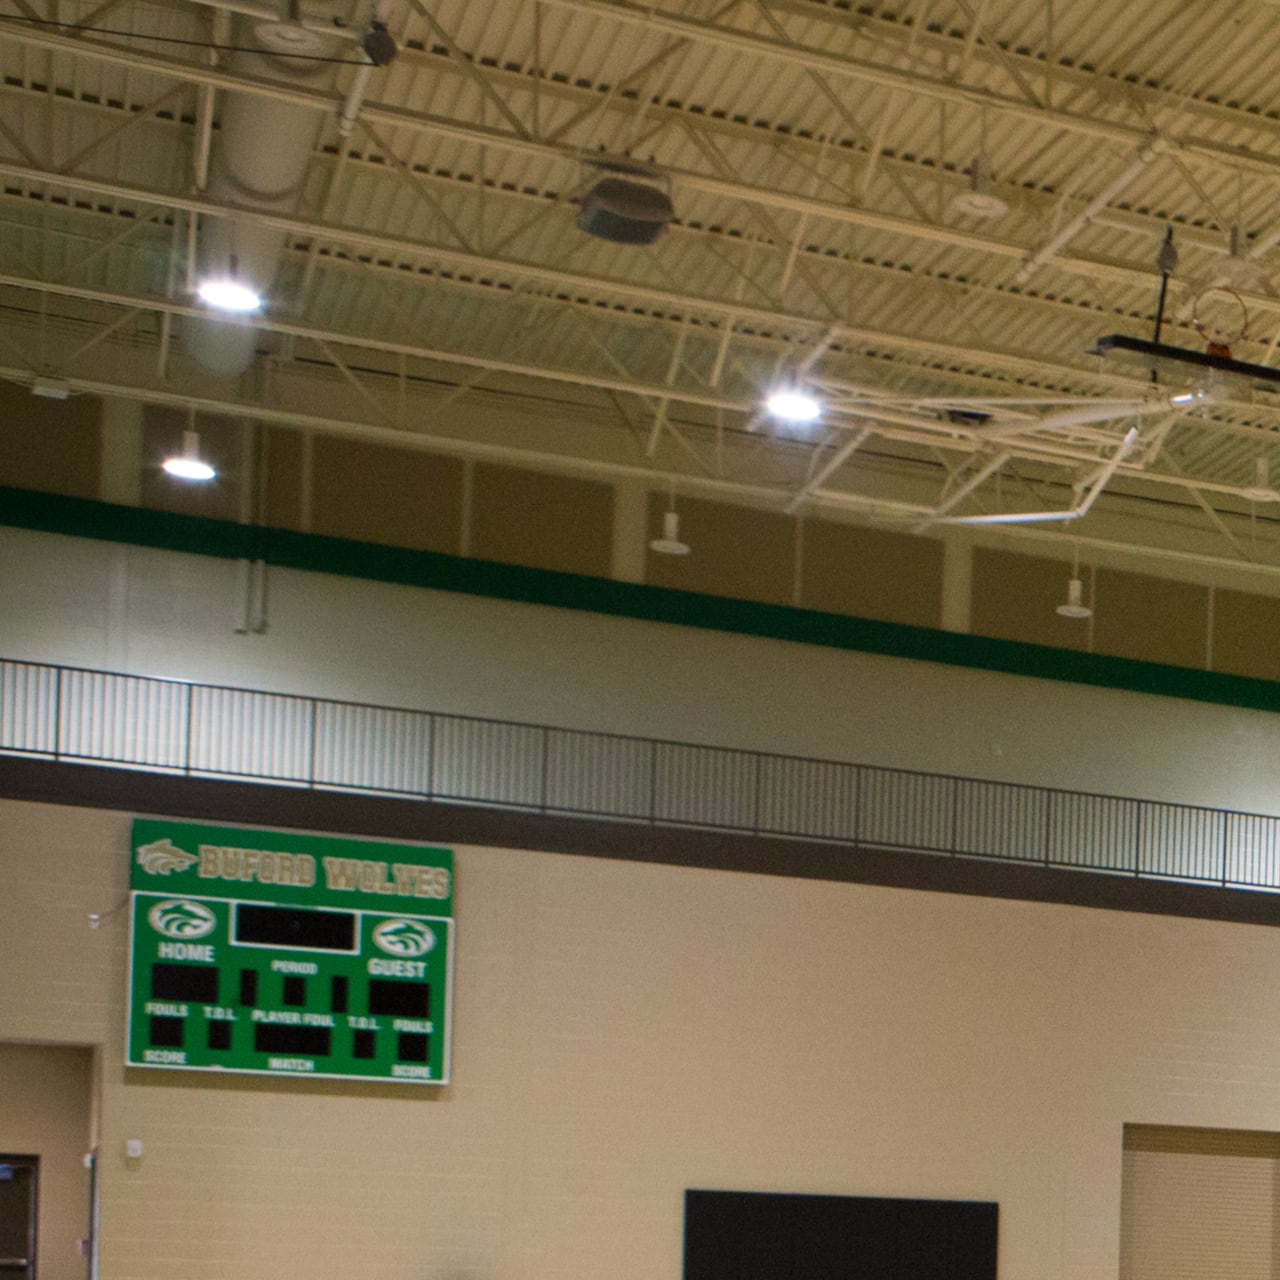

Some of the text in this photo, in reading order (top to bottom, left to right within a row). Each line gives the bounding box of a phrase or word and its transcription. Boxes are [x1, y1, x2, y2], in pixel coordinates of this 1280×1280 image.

[198, 845, 450, 900] BUFORD WOLVES
[158, 942, 216, 962] HOME
[271, 960, 318, 975] PERIOD
[367, 958, 428, 978] GUEST
[144, 1002, 188, 1018] FOULS
[251, 1010, 336, 1028] PLAYER FOUL
[392, 1019, 434, 1034] FOULS
[143, 1050, 187, 1064] SCORE
[391, 1064, 433, 1079] SCORE
